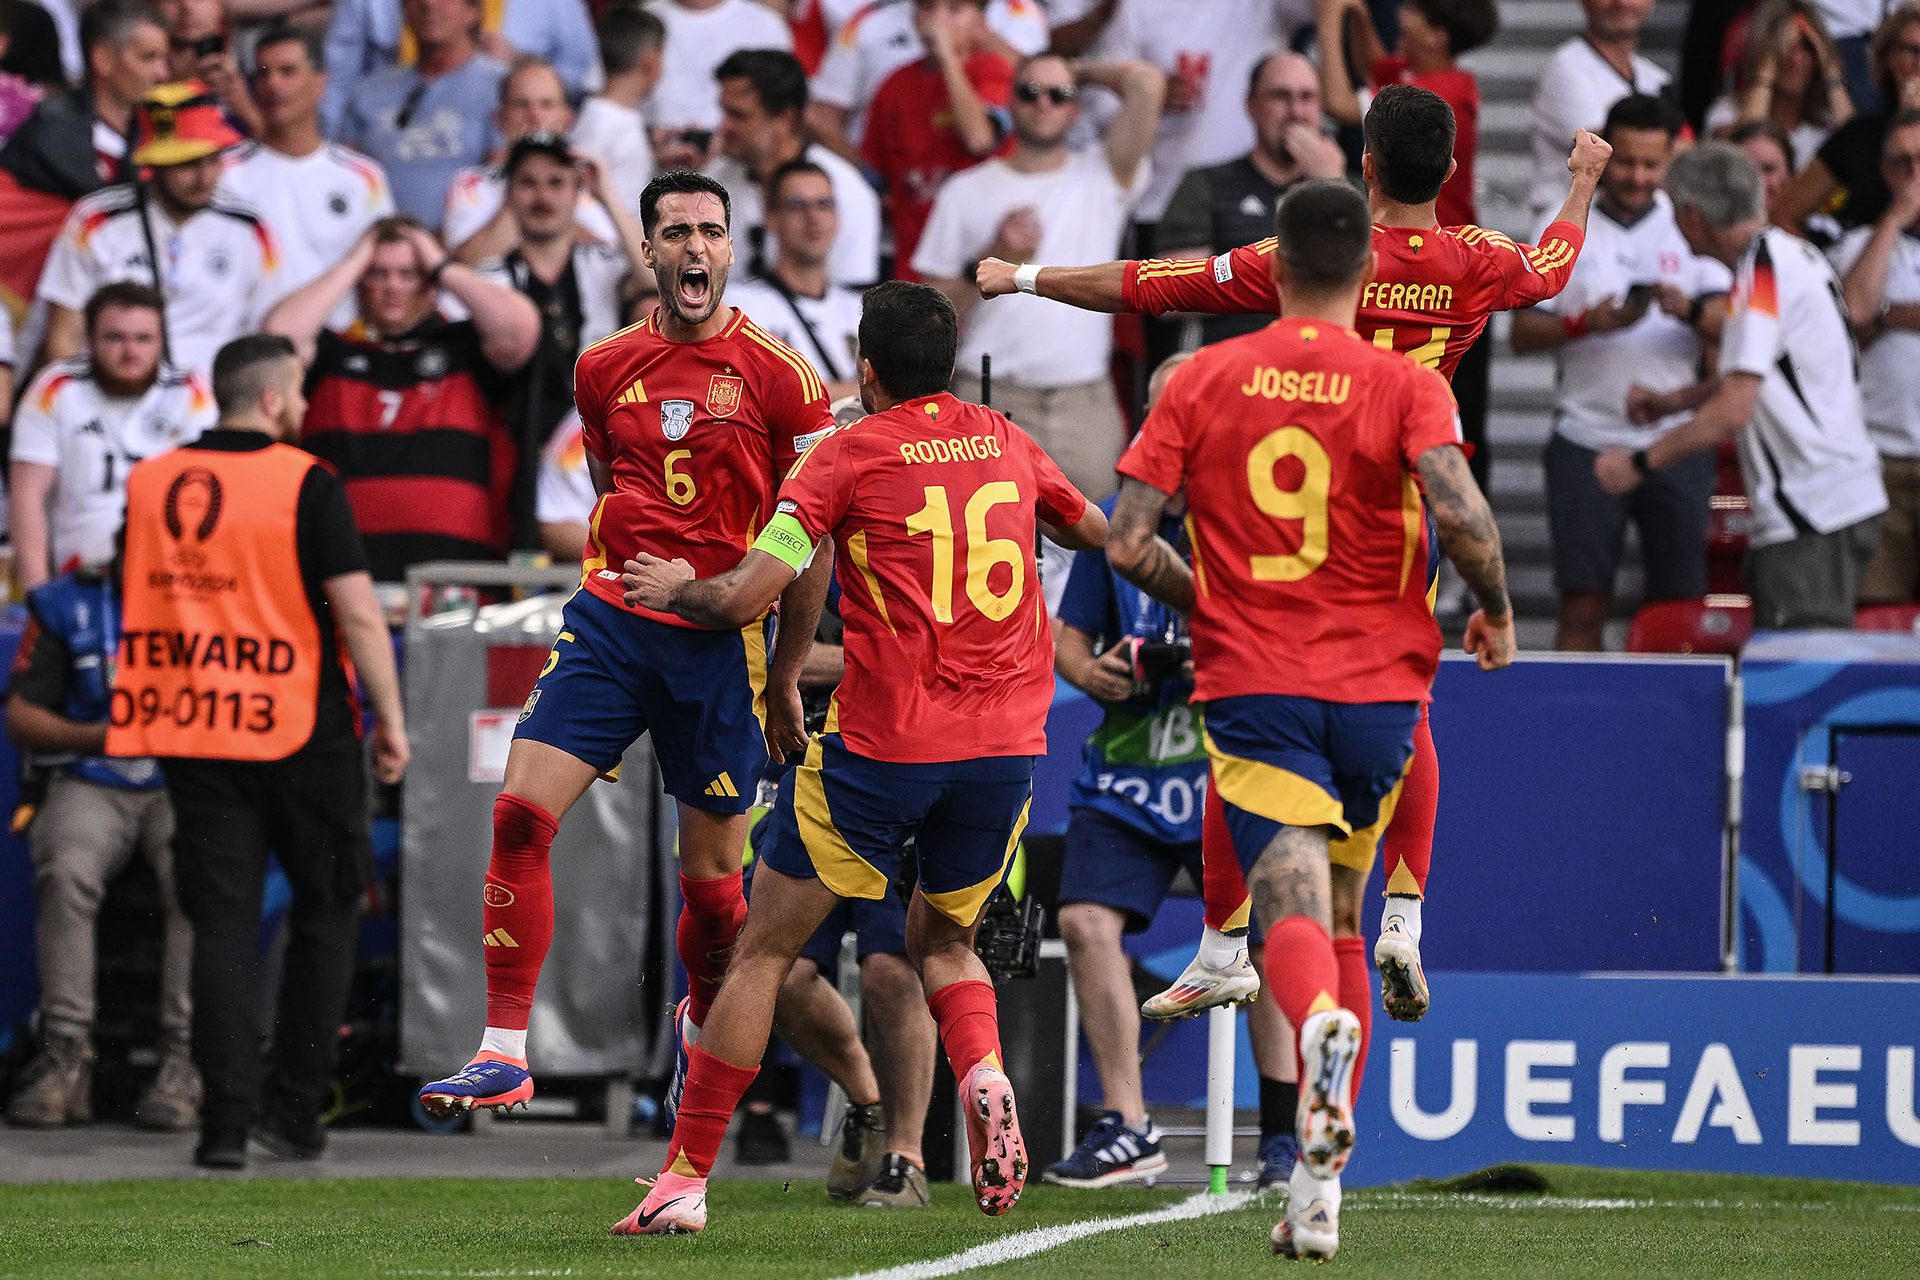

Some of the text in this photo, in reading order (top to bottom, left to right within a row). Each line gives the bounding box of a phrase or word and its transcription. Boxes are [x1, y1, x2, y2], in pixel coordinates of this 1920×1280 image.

[1362, 283, 1453, 310] FERRAN
[1241, 366, 1351, 405] JOSELU
[377, 389, 403, 429] 7
[899, 435, 1002, 465] RODRIGO
[664, 449, 696, 505] 6
[1247, 425, 1332, 582] 9
[770, 528, 805, 551] RESPECT
[904, 480, 1025, 623] 16
[110, 686, 275, 732] 09-0113
